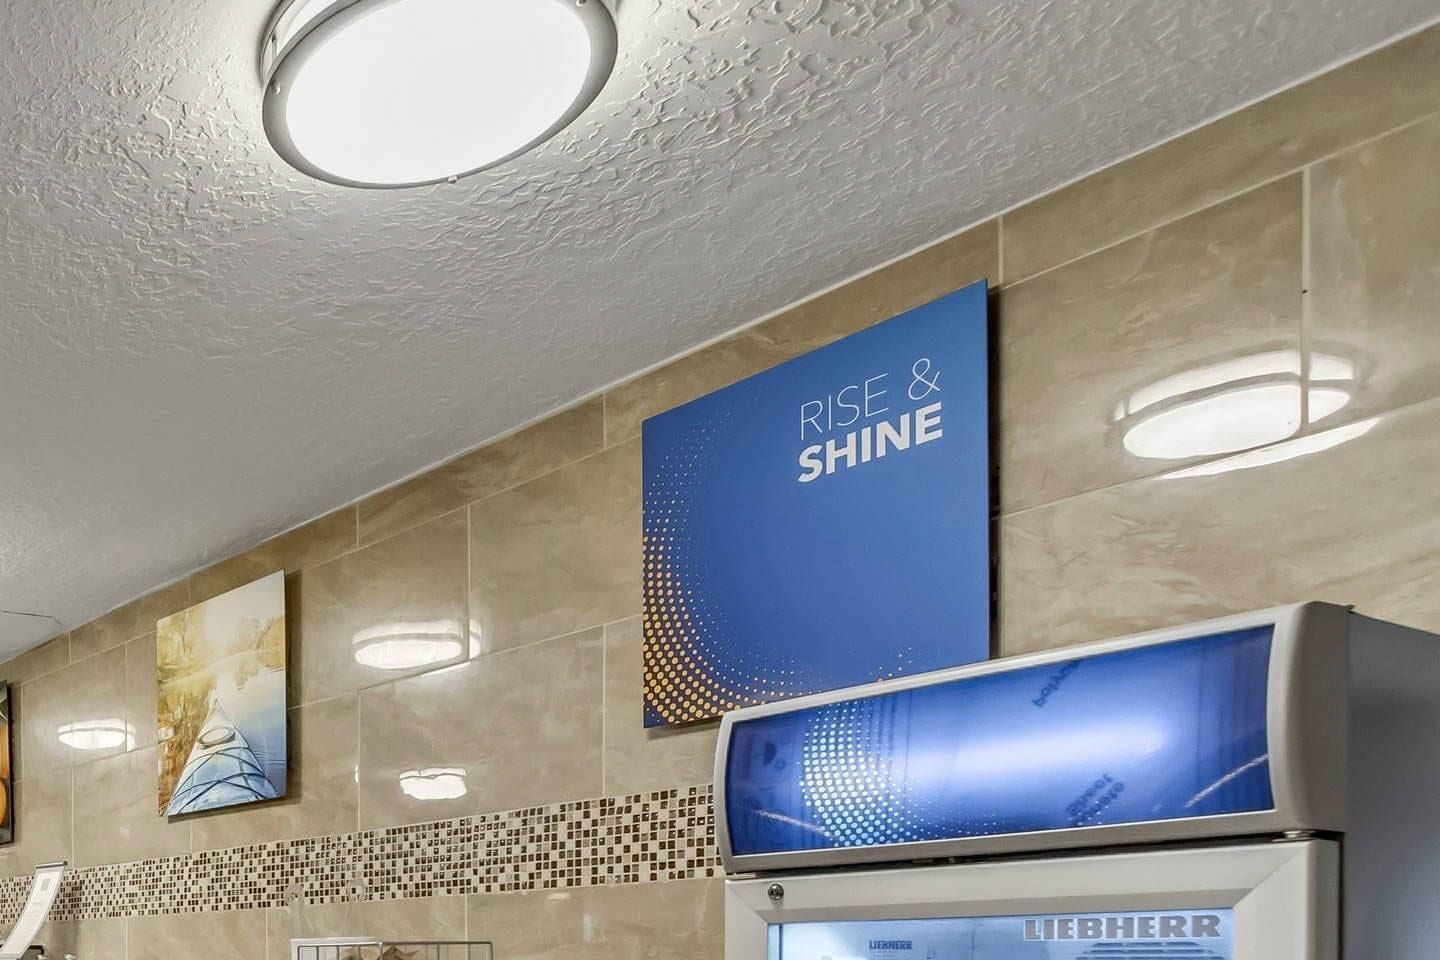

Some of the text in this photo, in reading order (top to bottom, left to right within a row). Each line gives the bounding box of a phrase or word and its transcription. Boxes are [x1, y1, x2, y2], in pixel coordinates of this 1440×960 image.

[801, 358, 943, 440] RISE &
[797, 401, 944, 483] SHINE
[869, 940, 913, 950] LIEBHERR
[1024, 914, 1221, 941] LIEBHERR
